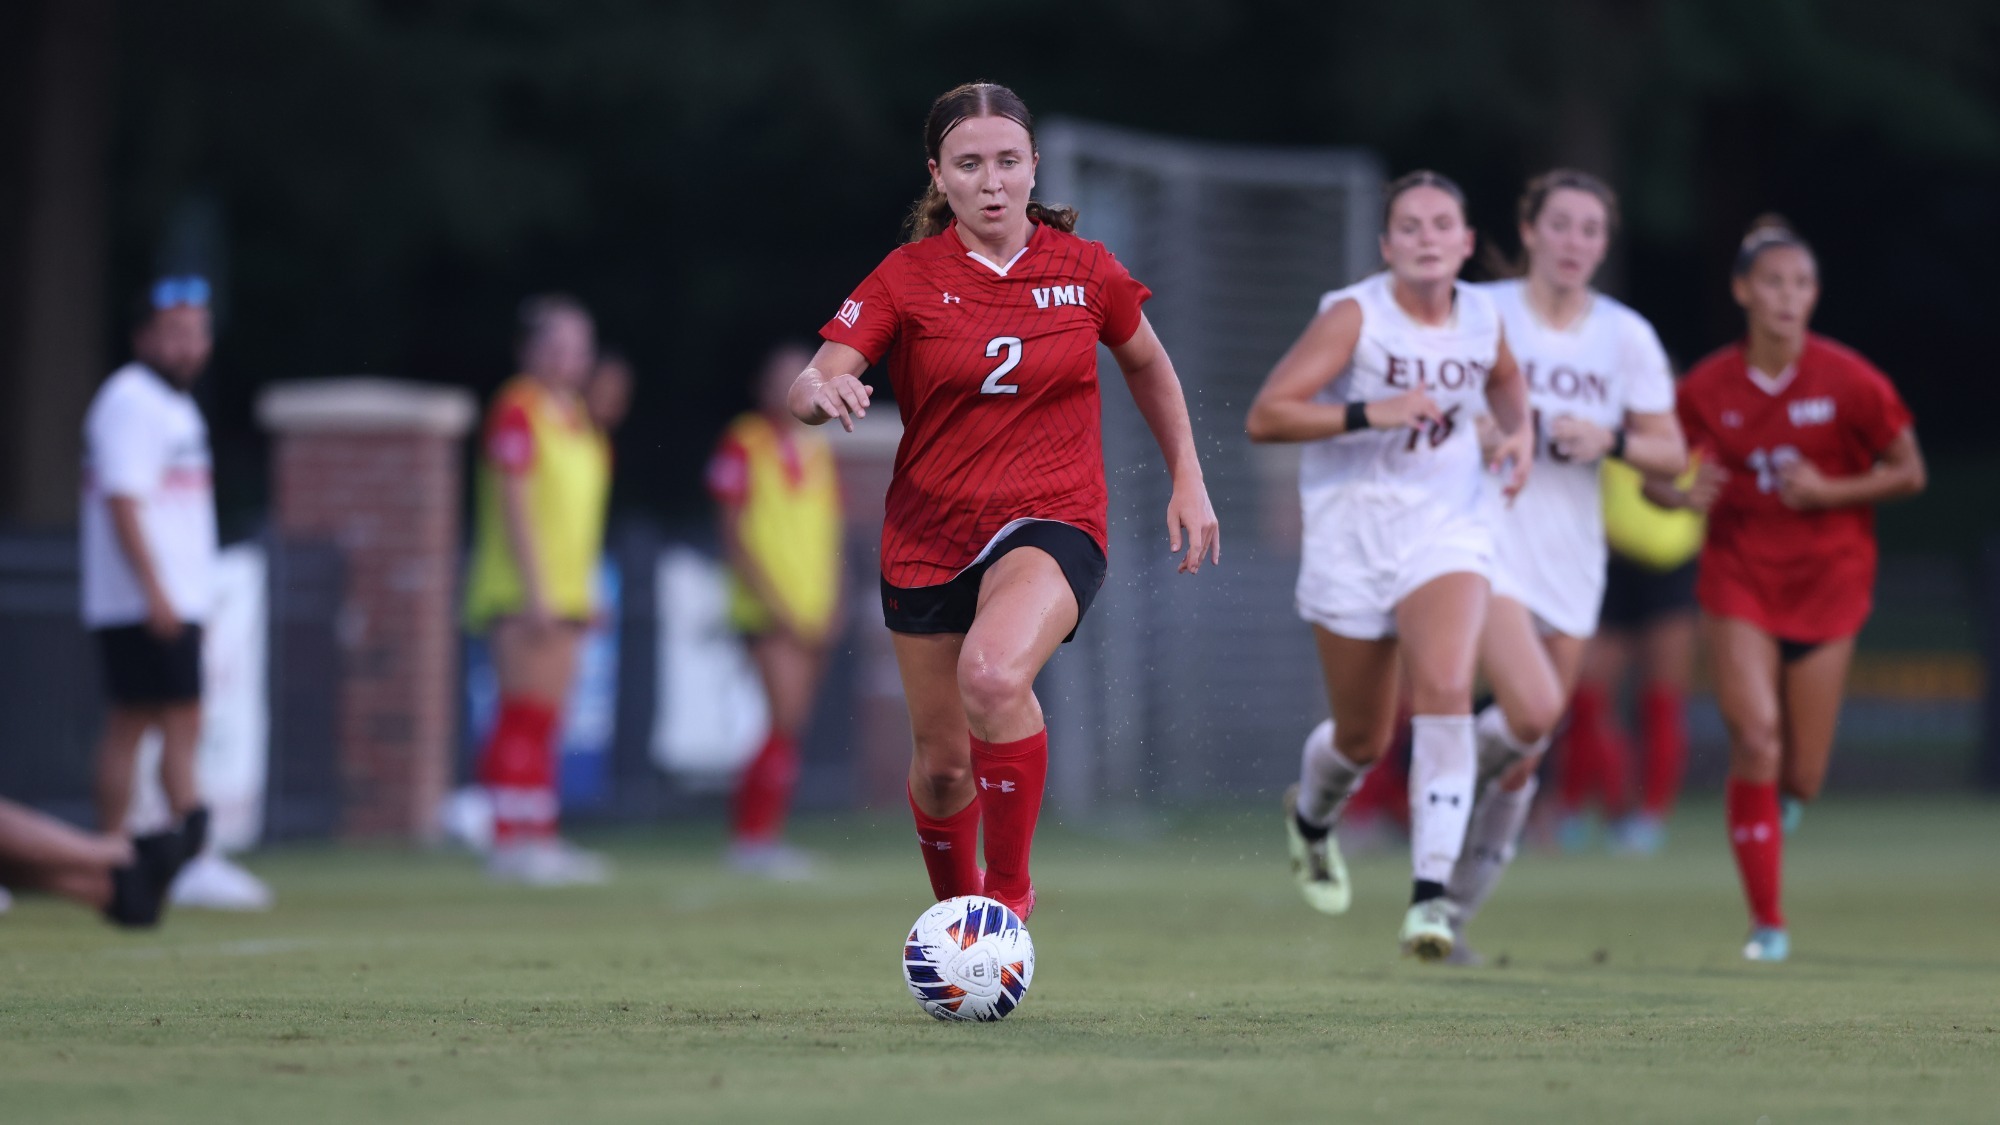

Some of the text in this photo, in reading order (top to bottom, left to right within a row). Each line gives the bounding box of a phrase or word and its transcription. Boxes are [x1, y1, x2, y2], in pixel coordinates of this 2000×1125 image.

[1031, 284, 1087, 309] VMI
[980, 335, 1024, 395] 2
[1525, 361, 1609, 402] LON
[991, 957, 1000, 979] NCAA
